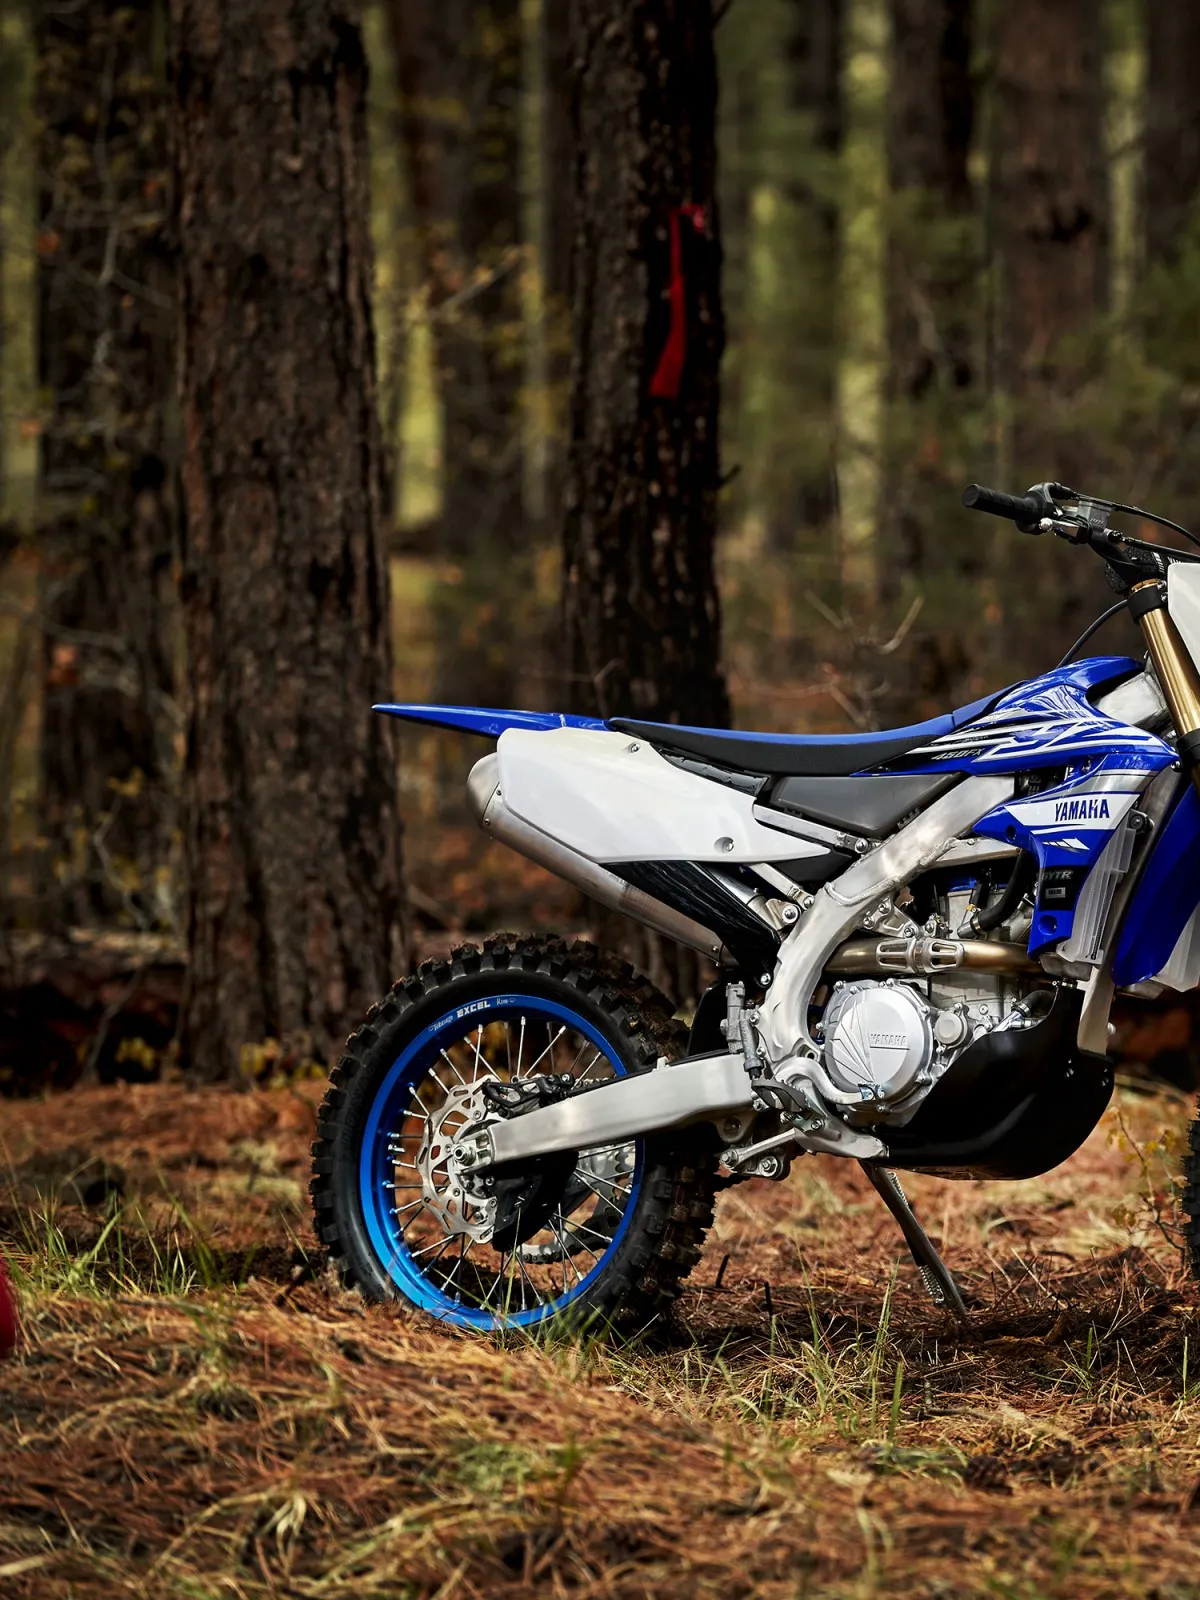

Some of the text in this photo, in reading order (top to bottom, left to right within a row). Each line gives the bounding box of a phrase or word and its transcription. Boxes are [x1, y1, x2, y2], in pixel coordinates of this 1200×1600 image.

[931, 748, 985, 760] 450FX
[1055, 798, 1110, 822] YAMAHA
[456, 1000, 491, 1018] EXCEL
[870, 1033, 906, 1046] YAMAHA
